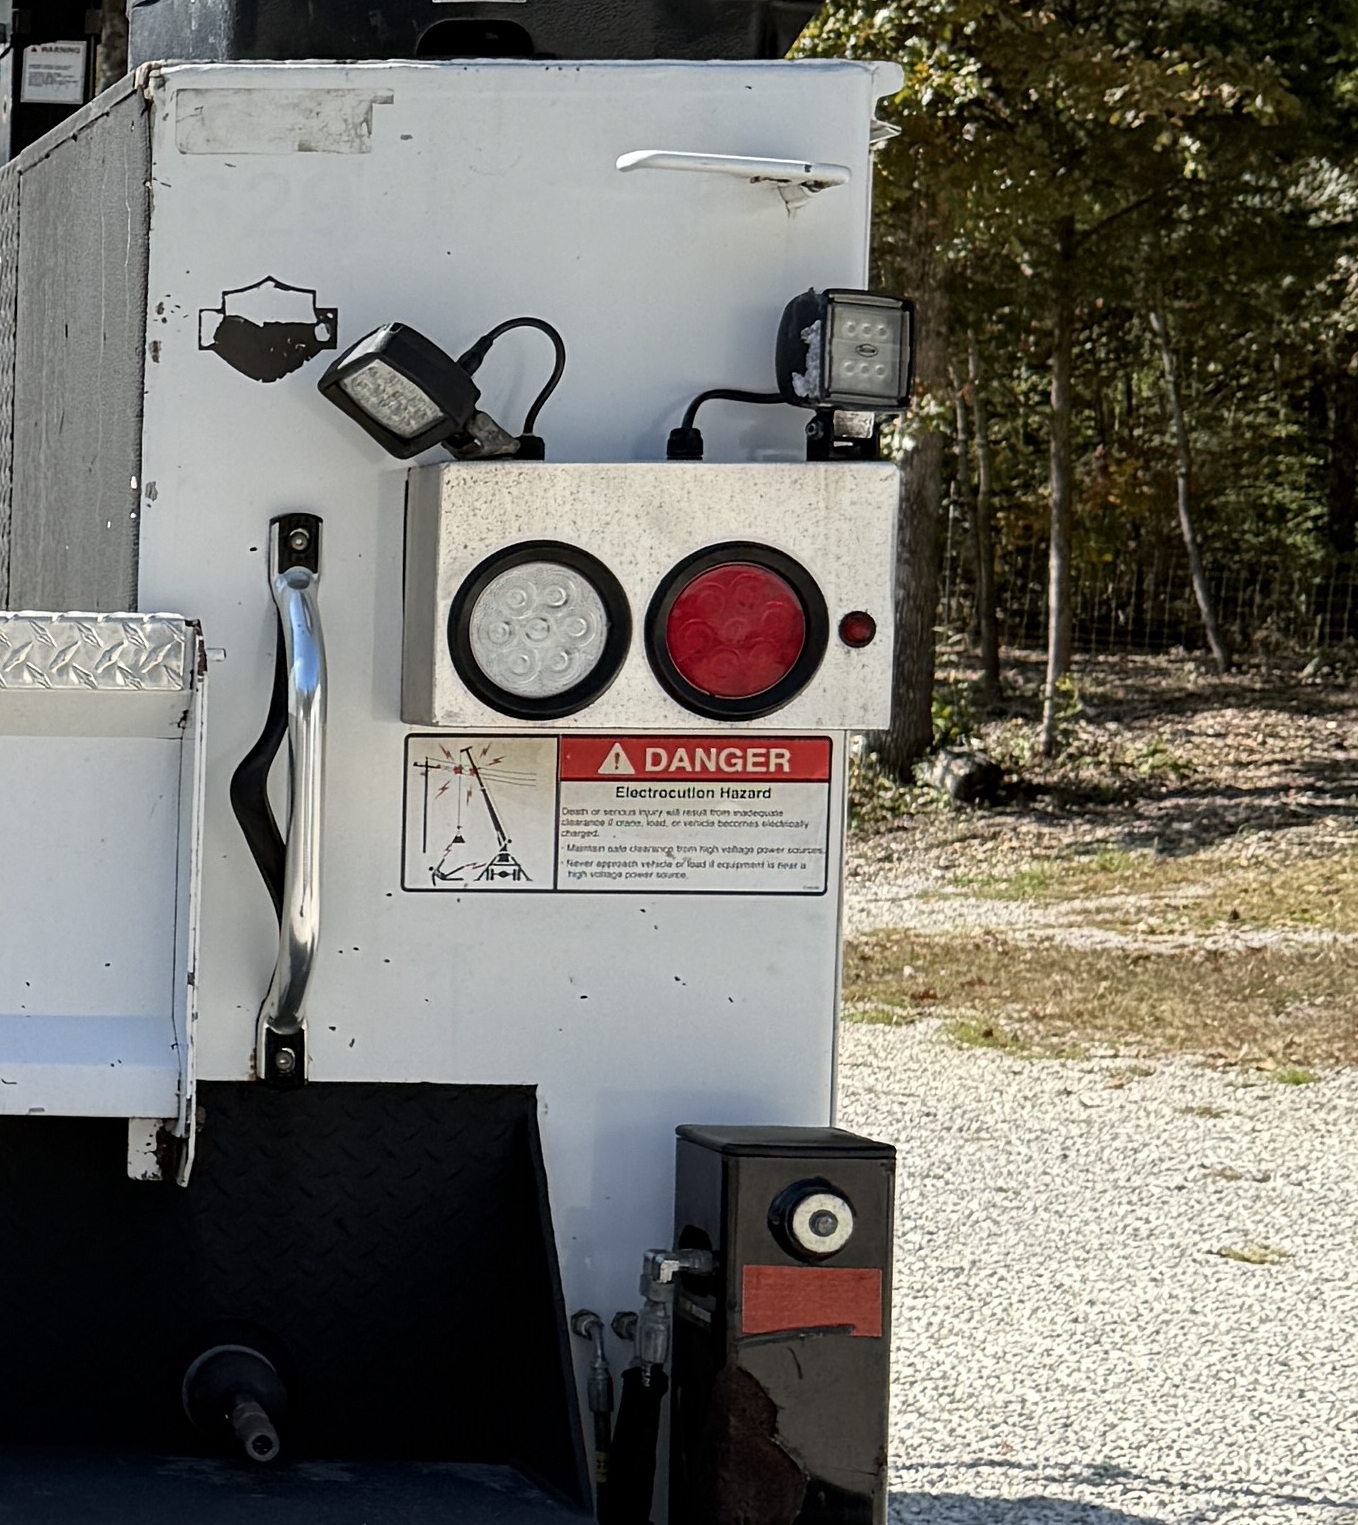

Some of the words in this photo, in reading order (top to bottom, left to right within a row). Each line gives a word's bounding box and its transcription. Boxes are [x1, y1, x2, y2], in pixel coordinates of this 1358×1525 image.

[645, 748, 791, 773] DANGER
[616, 786, 715, 800] Electrocution
[721, 787, 772, 800] Hazard
